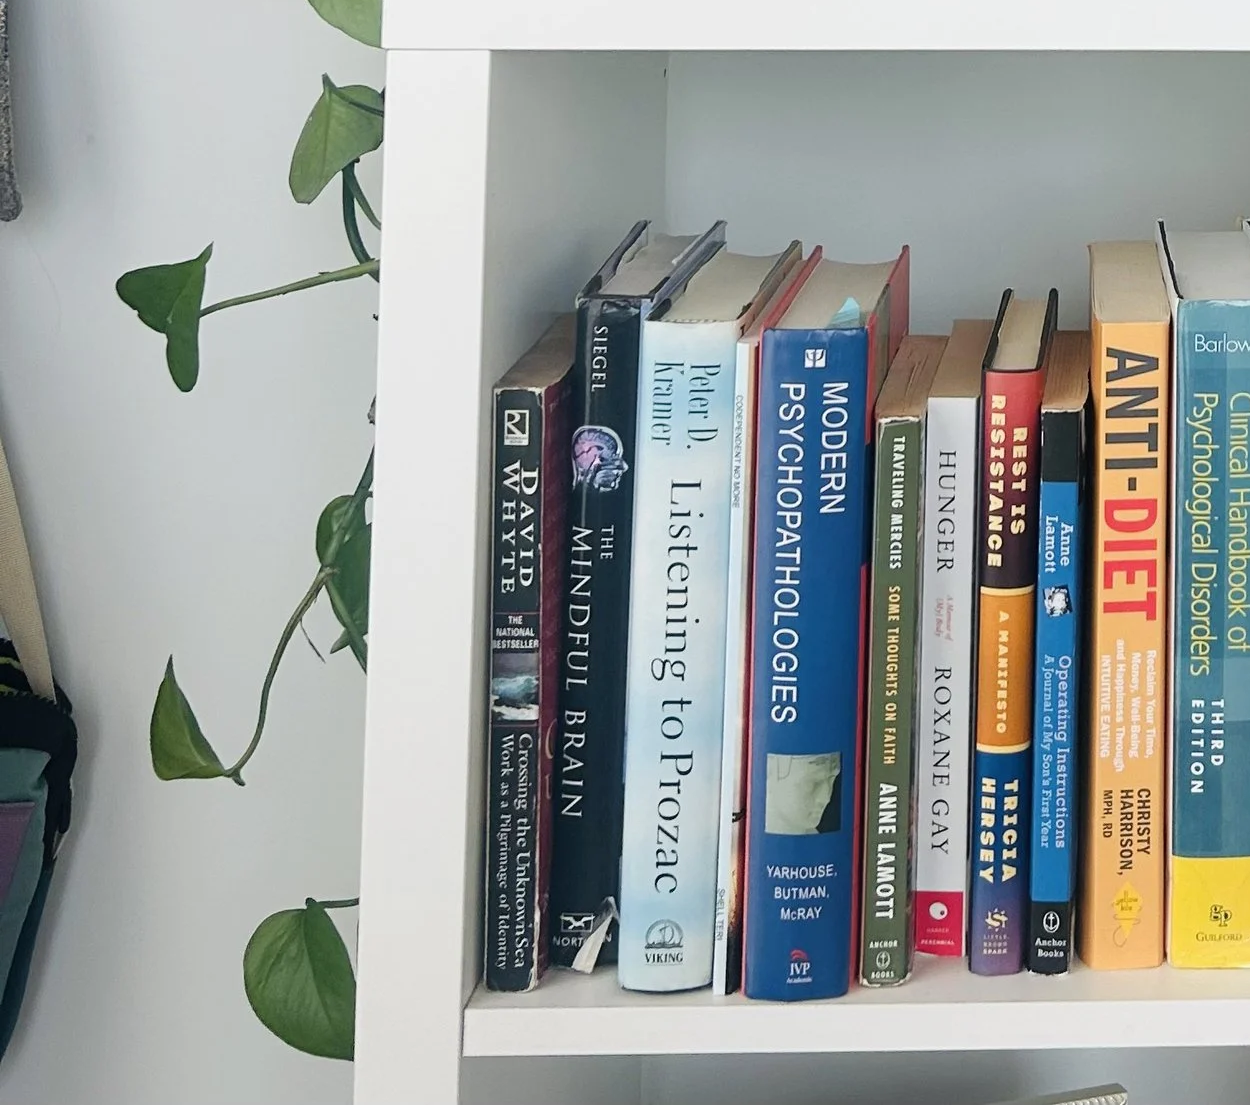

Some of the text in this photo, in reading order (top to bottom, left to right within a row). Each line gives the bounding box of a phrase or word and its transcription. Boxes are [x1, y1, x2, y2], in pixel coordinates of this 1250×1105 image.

[591, 325, 608, 392] SIEGEL
[651, 360, 685, 446] Kramer
[687, 363, 721, 449] Peter D.
[732, 395, 744, 508] CODEPENDENT NO MORE
[818, 382, 849, 514] MODERN
[987, 395, 1006, 567] RESISTANCE
[1010, 427, 1028, 535] REST IS
[1102, 347, 1159, 622] ANTI-DIET
[500, 459, 521, 594] WHYTE
[519, 467, 539, 587] DAVID
[600, 525, 614, 559] THE
[889, 436, 906, 569] TRAVELING MERCIES
[936, 451, 957, 573] HUNGER
[1185, 393, 1219, 676] Psychological Disorders
[770, 383, 806, 723] PSYCHOPATHOLOGIES
[1044, 515, 1058, 573] Lamott
[1060, 523, 1073, 566] Anne
[496, 627, 535, 637] NATIONAL
[508, 615, 523, 624] THE
[561, 525, 592, 818] MINDFUL BRAIN
[651, 479, 704, 894] Listening to Prozac
[883, 586, 901, 765] SOME THOUGHTS ON FAITH
[996, 611, 1009, 734] A MANIFESTO
[1042, 667, 1055, 713] Journal
[1044, 654, 1054, 665] A
[1040, 732, 1053, 751] My
[1042, 715, 1053, 729] of
[1100, 654, 1111, 758] INTUITIVE EATING
[1113, 639, 1126, 772] and Happiness Through
[1128, 652, 1141, 758] Money, Well-Being
[1144, 650, 1157, 759] Reclaim Your Time,
[1210, 699, 1225, 766] THIRD
[500, 733, 514, 777] Work
[931, 667, 952, 855] ROXANE GAY
[1054, 655, 1072, 848] Operating Instructions
[1190, 700, 1205, 794] EDITION
[500, 782, 510, 795] as
[1041, 789, 1052, 821] First
[1100, 790, 1113, 838] MPH, RD
[1136, 788, 1151, 855] CHRISTY
[496, 814, 512, 888] Pilgrimage
[514, 733, 533, 968] Crossing the Unknown Sea
[875, 783, 898, 919] ANNE LAMOTT
[979, 777, 996, 884] HERSEY
[1001, 779, 1019, 882] TRICIA
[1040, 823, 1052, 848] Year
[1116, 790, 1134, 875] HARRISON,
[499, 894, 510, 909] of
[766, 863, 837, 880] YARHOUSE,
[774, 886, 830, 900] BUTMAN,
[495, 915, 510, 970] Identity
[780, 906, 822, 920] McRAY
[869, 940, 898, 949] ANCHOR
[1035, 937, 1067, 947] Anchor
[1196, 932, 1243, 942] GUILFORD
[645, 953, 683, 964] VIKING
[789, 962, 811, 976] IVP
[1038, 949, 1064, 958] Books
